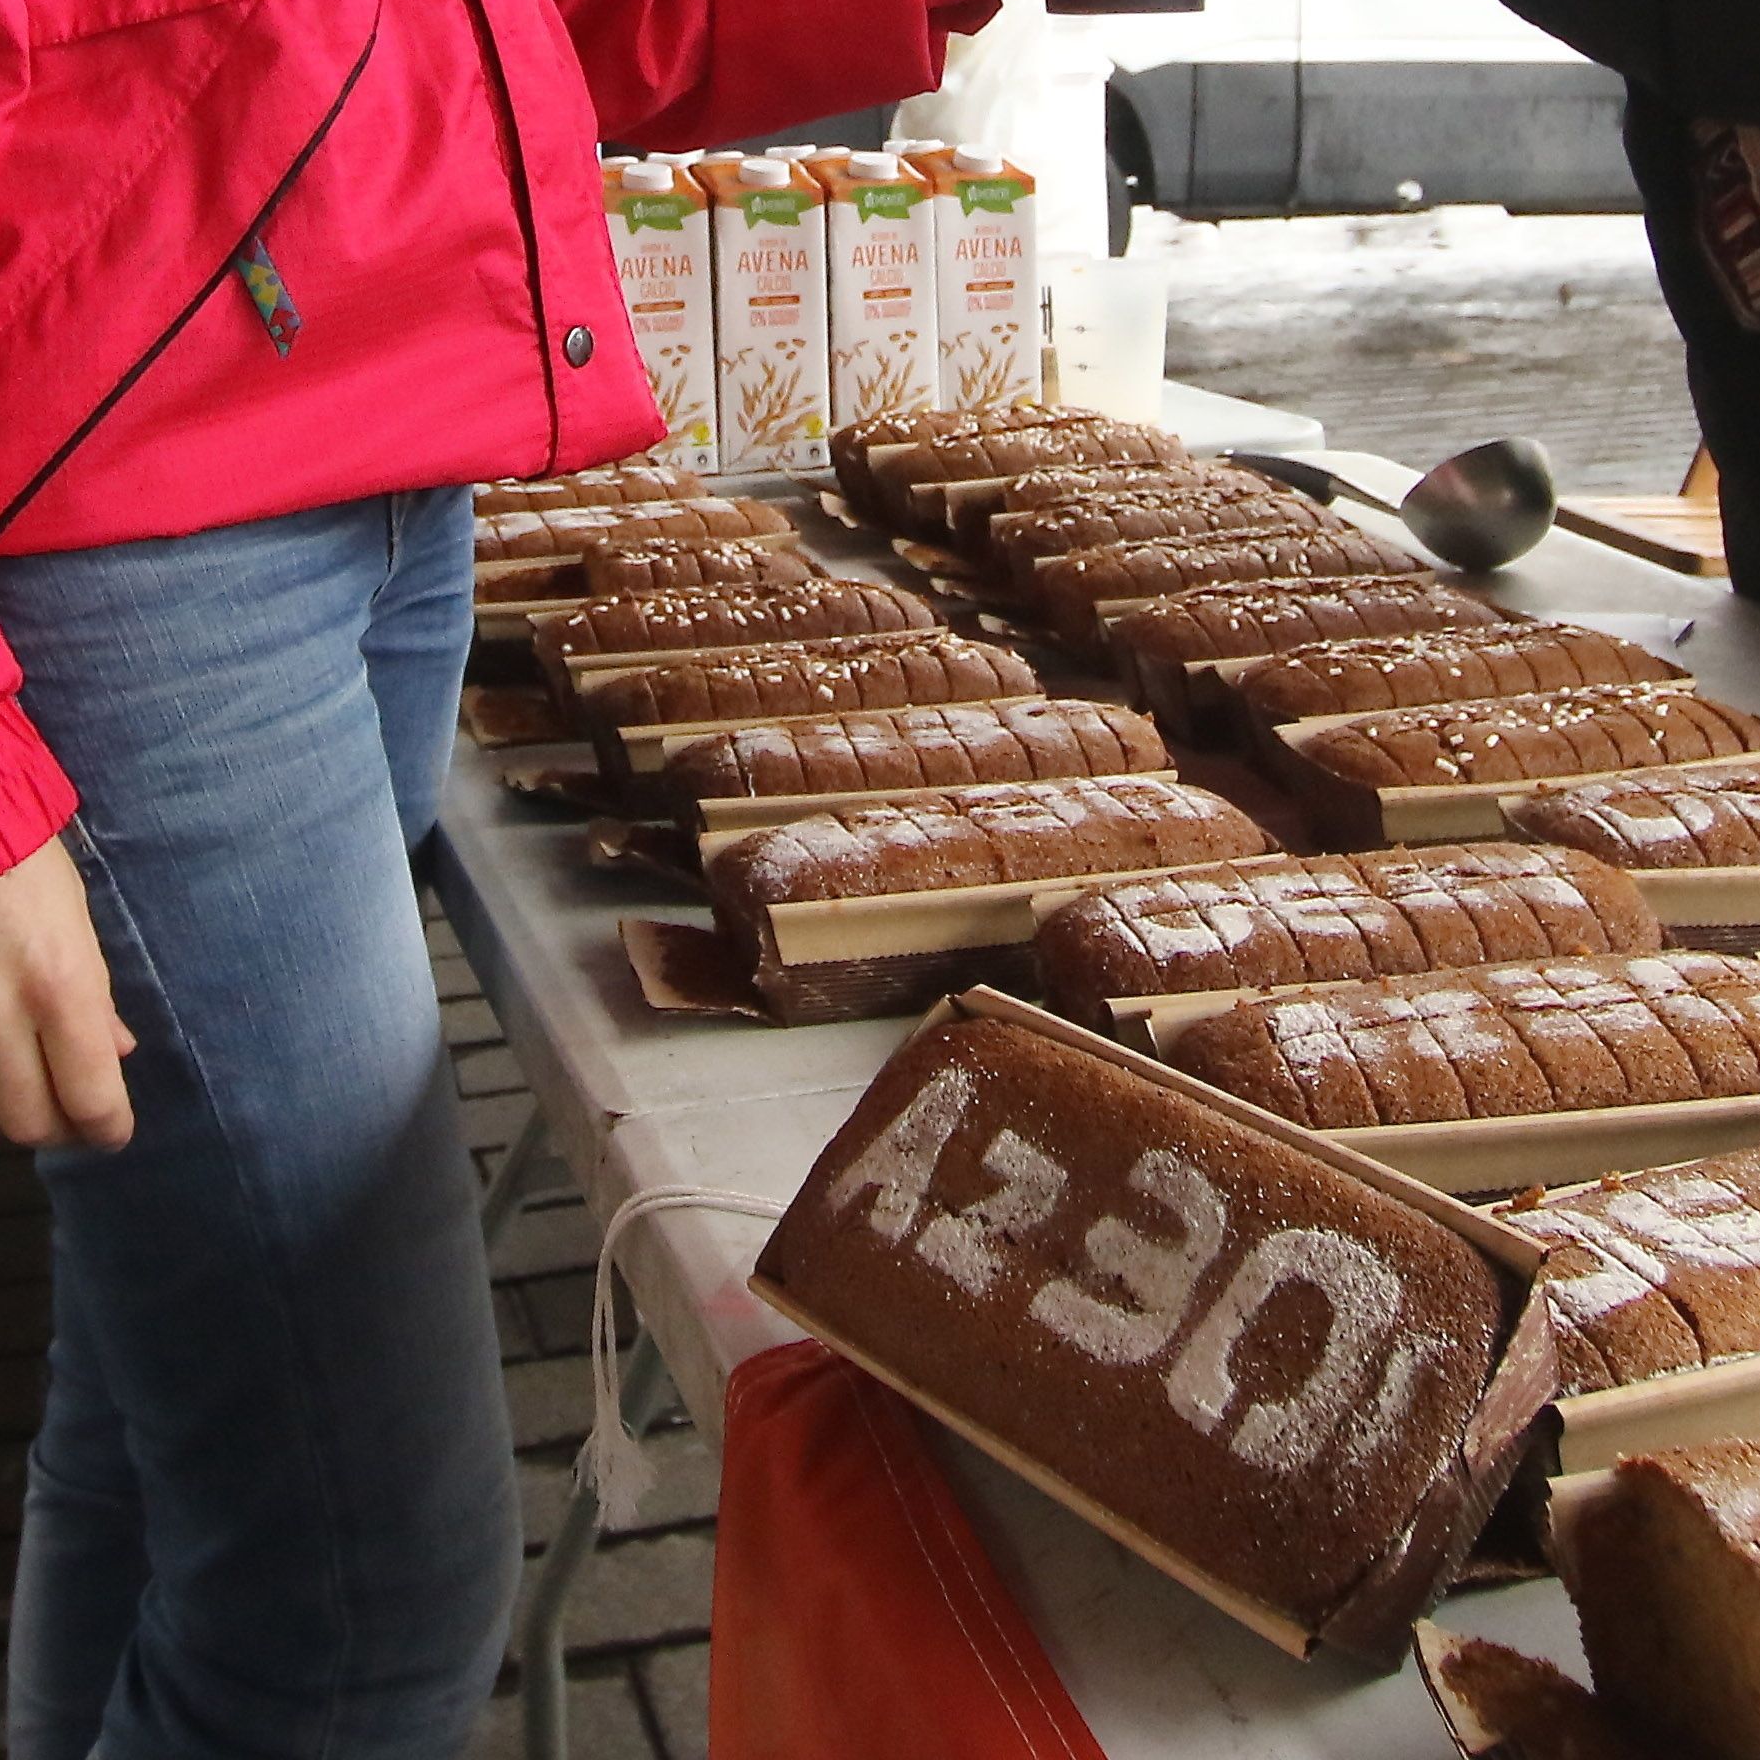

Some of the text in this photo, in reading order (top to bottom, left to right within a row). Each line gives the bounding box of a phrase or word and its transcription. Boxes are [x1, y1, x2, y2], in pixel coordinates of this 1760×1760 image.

[852, 243, 919, 268] AVENA
[956, 237, 1022, 260] AVENA
[621, 254, 693, 280] AVENA
[738, 250, 809, 274] AVENA
